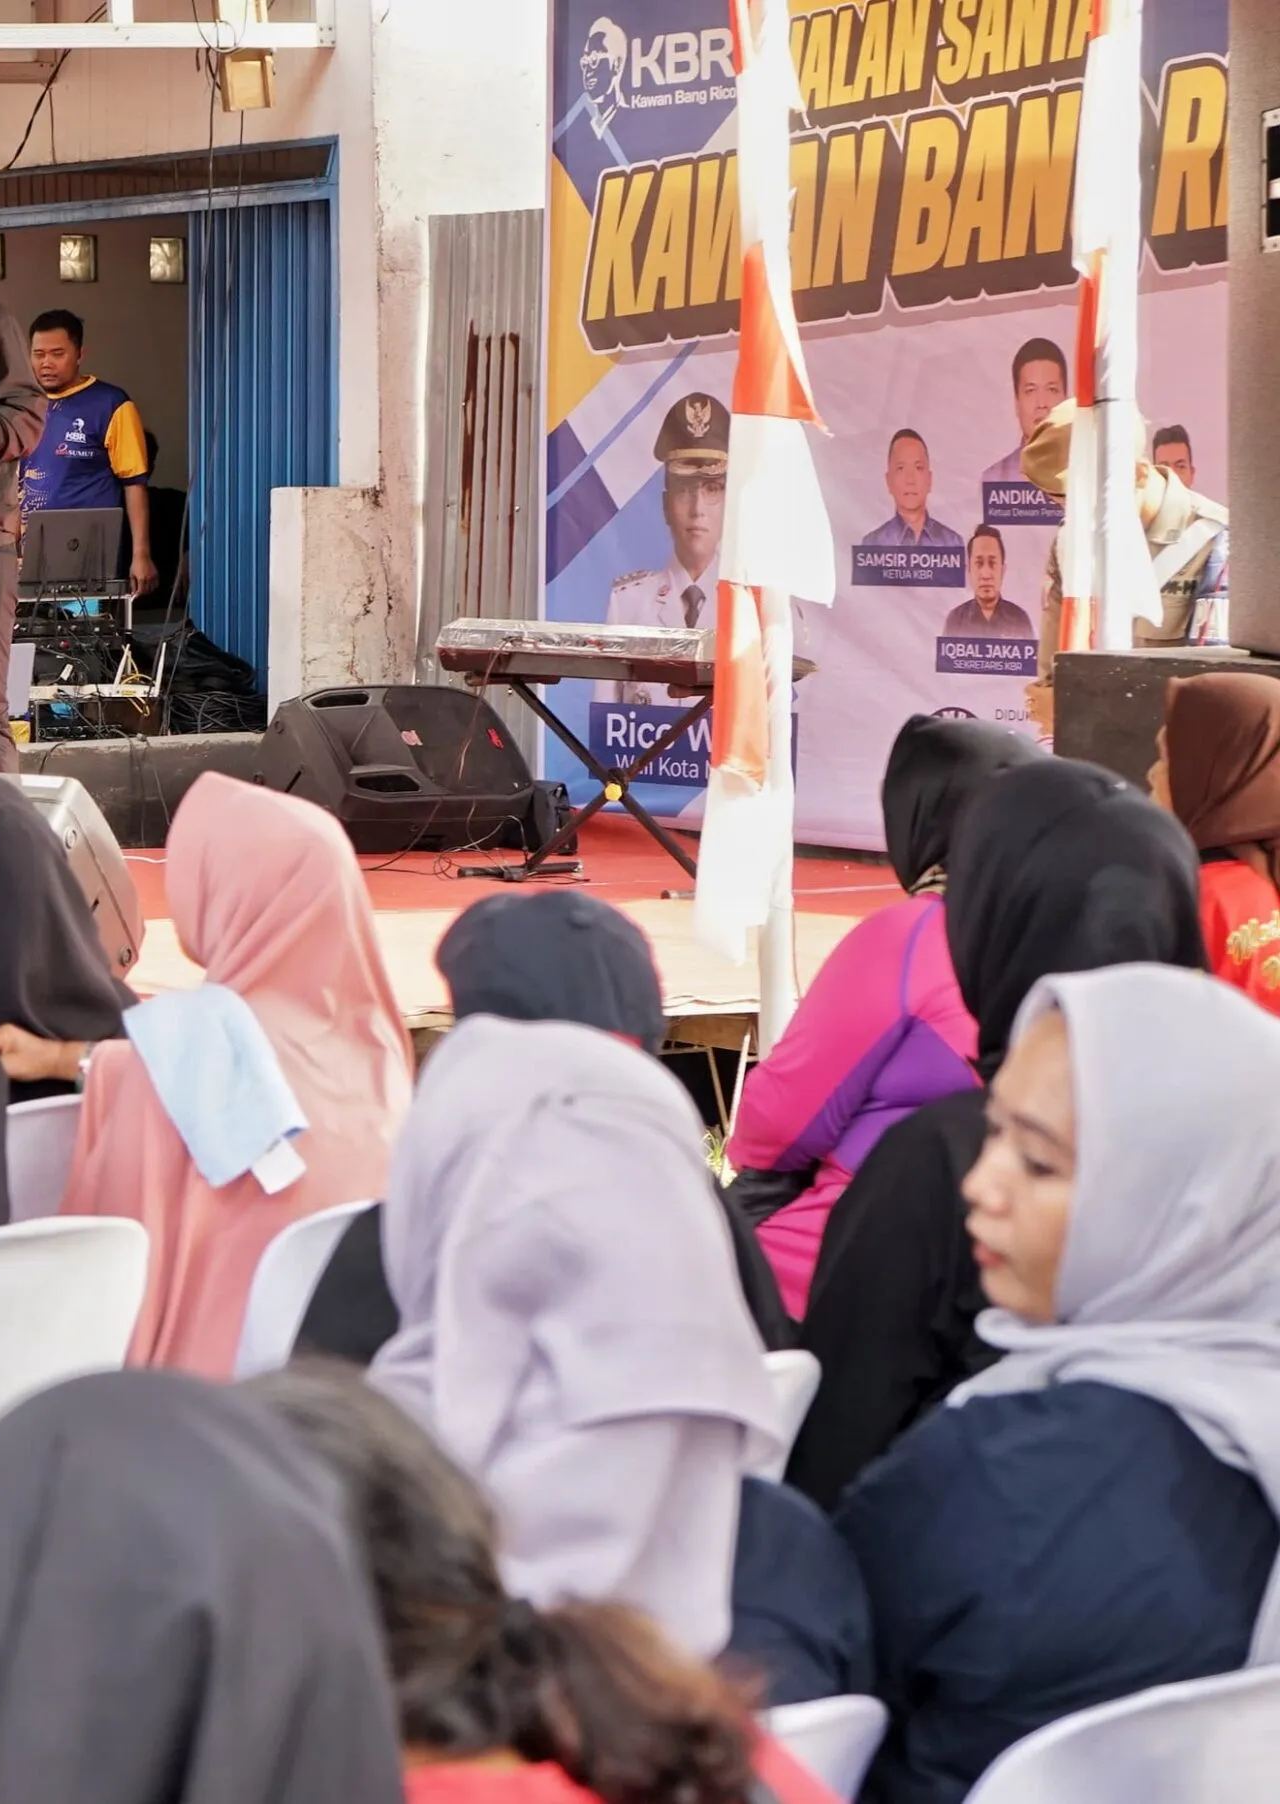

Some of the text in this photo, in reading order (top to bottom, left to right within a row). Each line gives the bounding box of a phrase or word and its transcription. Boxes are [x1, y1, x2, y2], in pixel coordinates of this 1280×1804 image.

[631, 28, 736, 88] KBR
[631, 85, 736, 109] Kawan Bang Rico
[891, 91, 1081, 276] BAN
[988, 489, 1047, 505] ANDIKA
[856, 552, 960, 568] SAMSIR POHAN
[882, 569, 933, 580] KETUA KBR
[941, 643, 1037, 660] IQBAL JAKA P.
[953, 660, 1004, 670] SEKRETARIS
[659, 756, 699, 779] Kota
